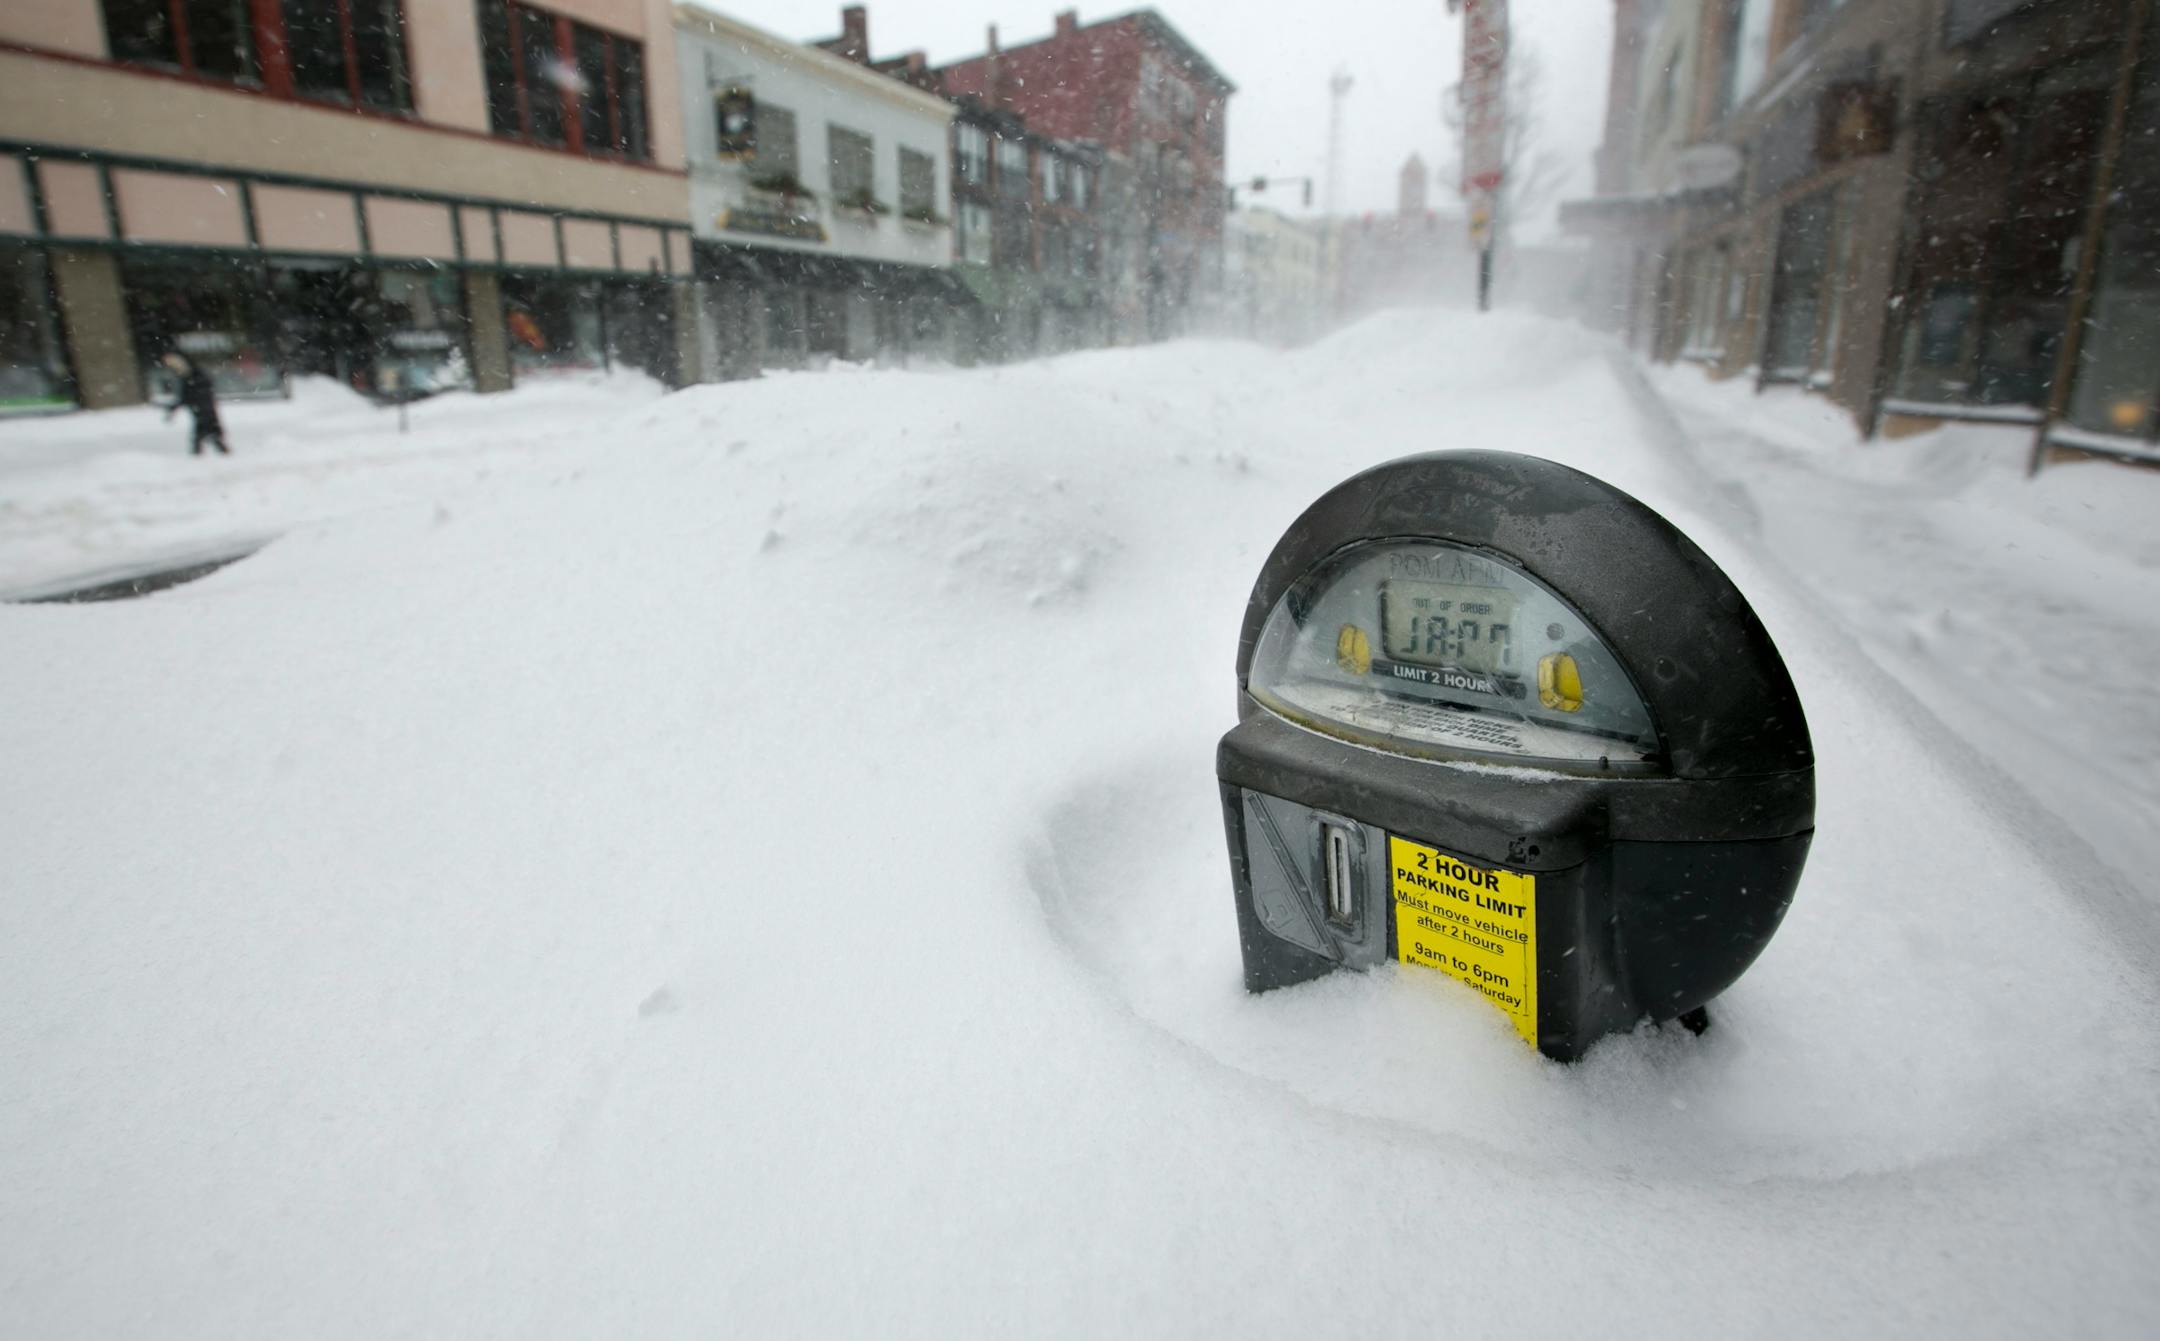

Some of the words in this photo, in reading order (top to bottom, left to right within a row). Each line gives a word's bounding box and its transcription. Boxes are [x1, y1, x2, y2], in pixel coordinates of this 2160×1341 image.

[1390, 552, 1441, 579] POM
[1440, 601, 1451, 610] OF
[1460, 602, 1491, 615] ORDER
[1393, 665, 1427, 681] LIMIT
[1431, 672, 1440, 684] 2
[1417, 852, 1428, 870] 2
[1435, 858, 1500, 892] HOUR
[1397, 867, 1470, 902] PARKING
[1476, 894, 1527, 918] LIMIT
[1397, 890, 1429, 911] Must
[1433, 905, 1470, 924] move
[1474, 919, 1528, 942] vehicle
[1417, 915, 1447, 933] after
[1451, 926, 1459, 938] 2
[1463, 929, 1504, 954] hours
[1415, 942, 1447, 964] 9am
[1452, 957, 1468, 972] to
[1473, 964, 1509, 987] 6pm
[1464, 977, 1521, 1008] Saturday
